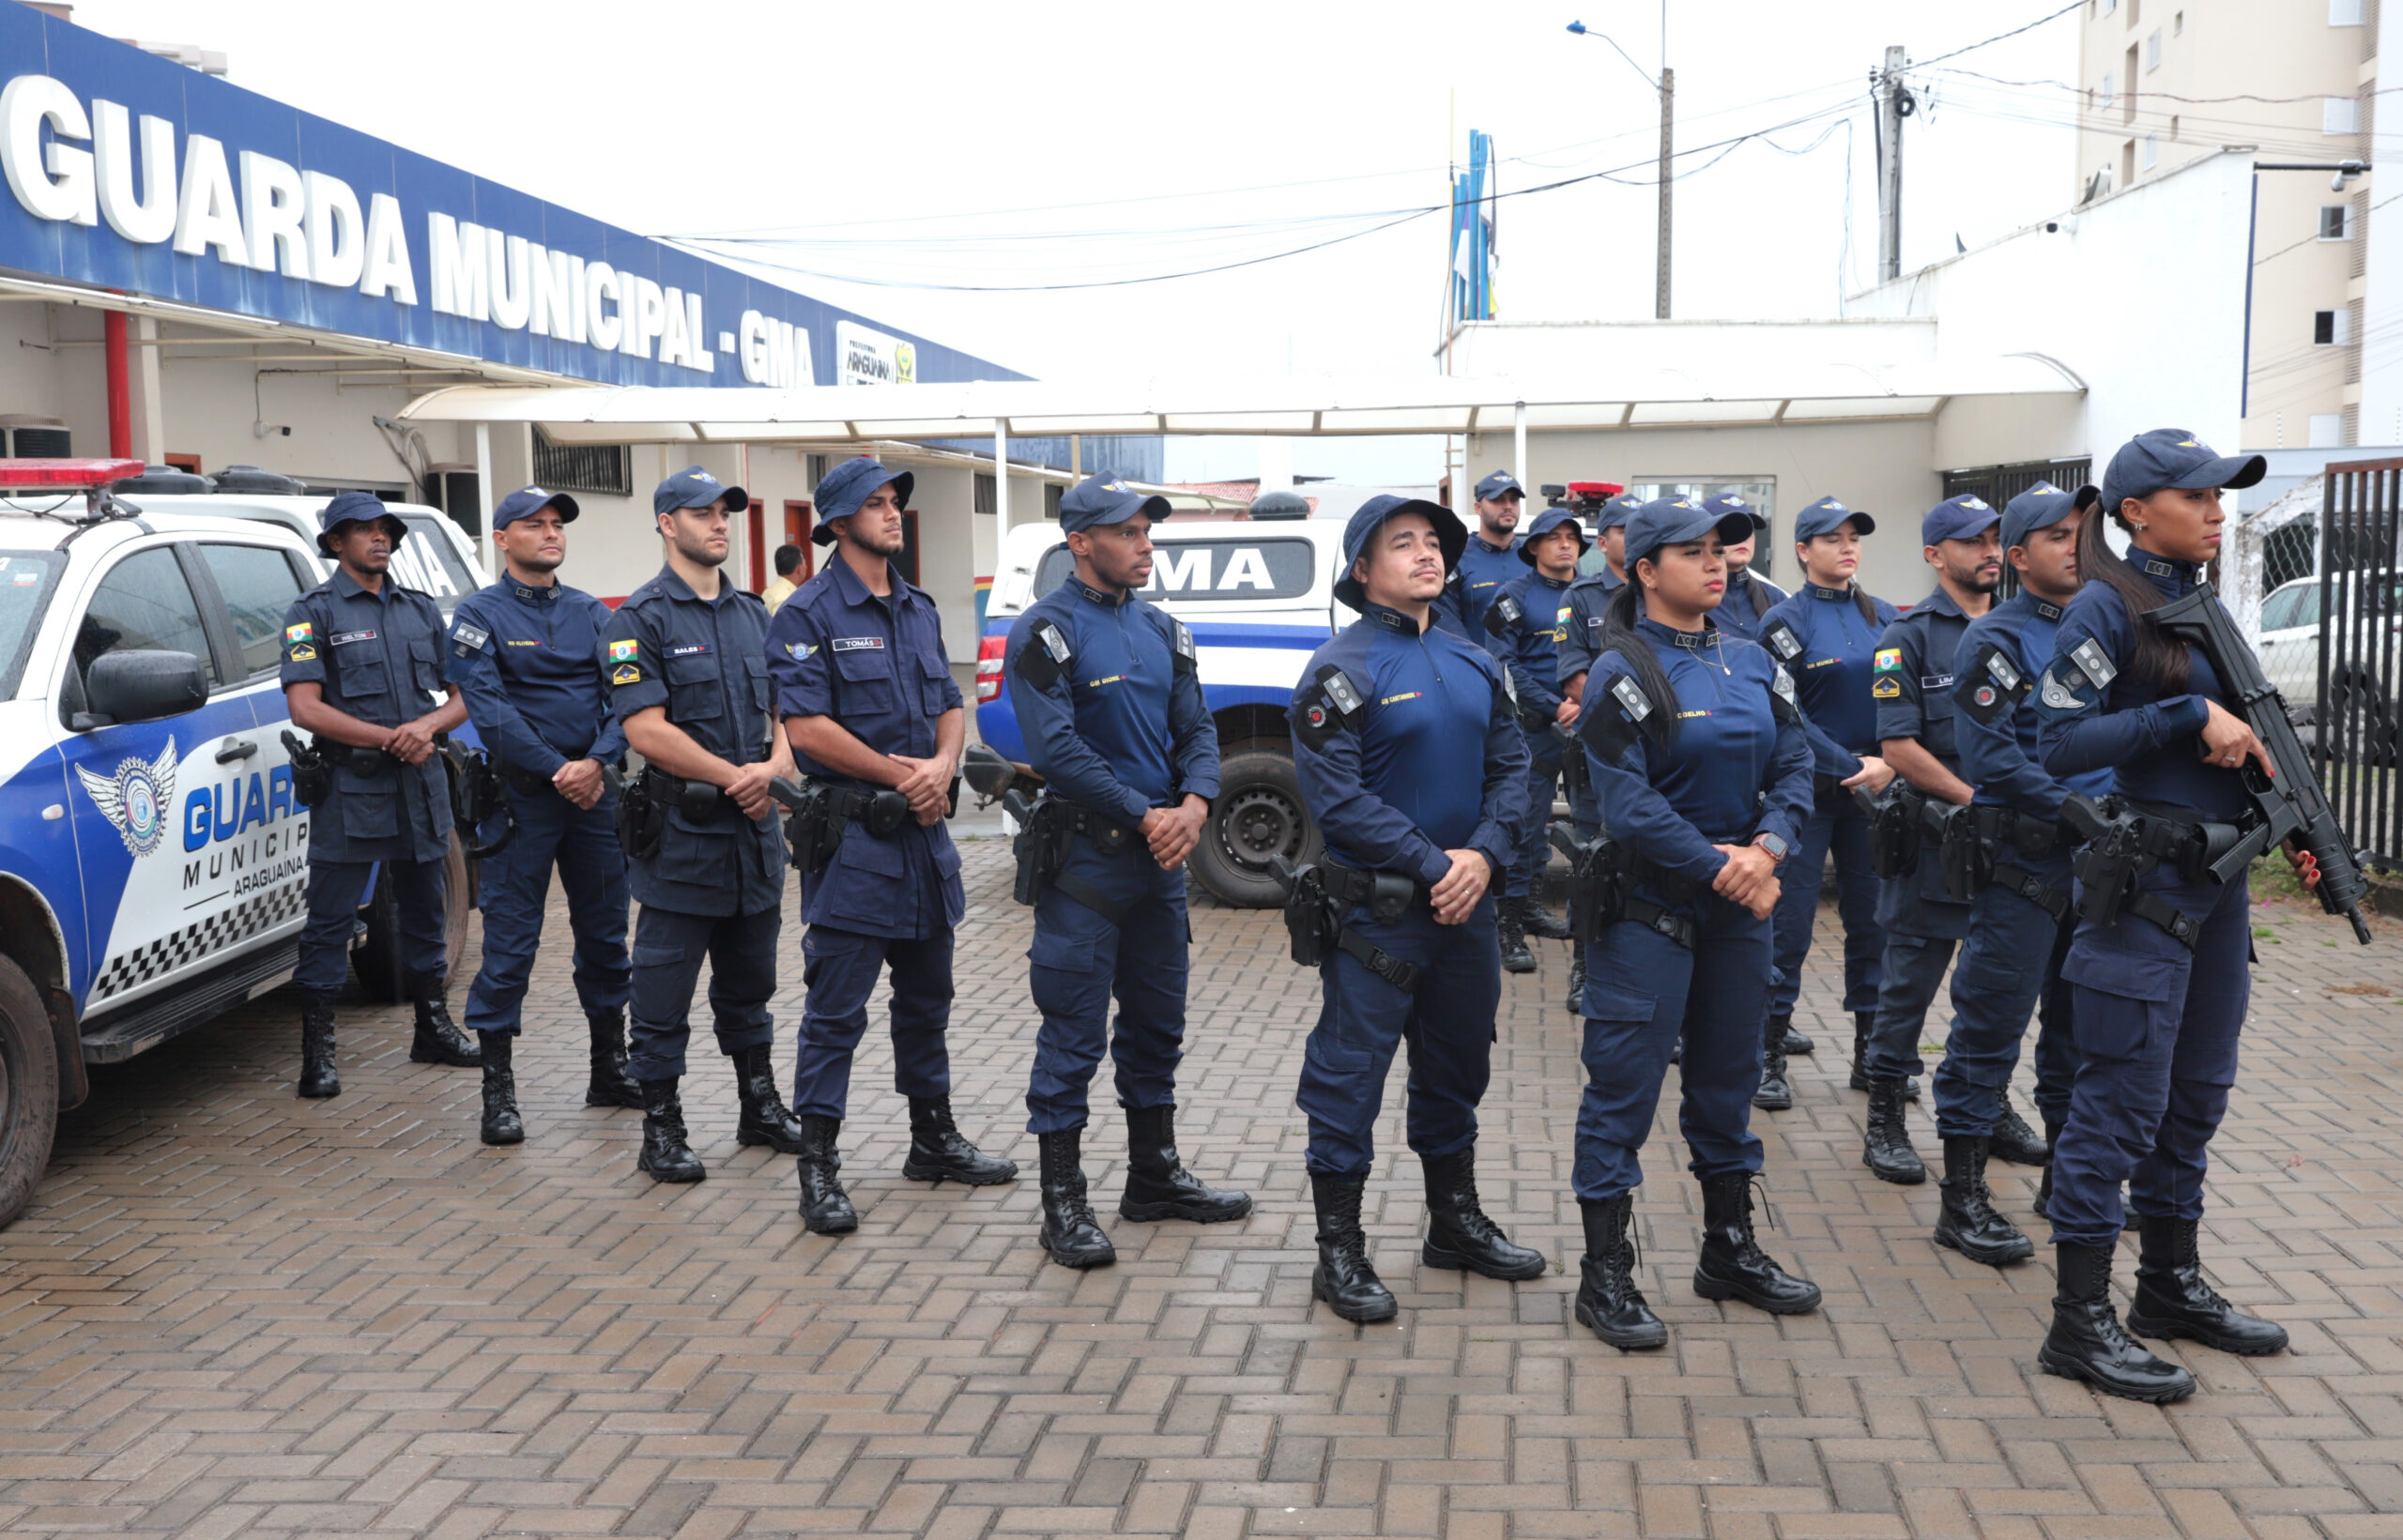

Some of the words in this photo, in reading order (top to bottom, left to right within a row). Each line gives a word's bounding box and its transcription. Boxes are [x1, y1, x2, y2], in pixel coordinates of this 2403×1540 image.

[0, 75, 418, 306] GUARDA
[429, 212, 714, 374] MUNICIPAL
[740, 310, 816, 388] GMA
[386, 531, 459, 598] MA
[674, 646, 698, 655] SALES
[845, 637, 874, 648] TOMÁS
[1089, 679, 1100, 688] GM
[1101, 675, 1120, 684] DIONE
[1677, 710, 1706, 719] COELHO
[183, 822, 308, 891] MUNICIP
[234, 855, 305, 898] ARAGUAÍNA
